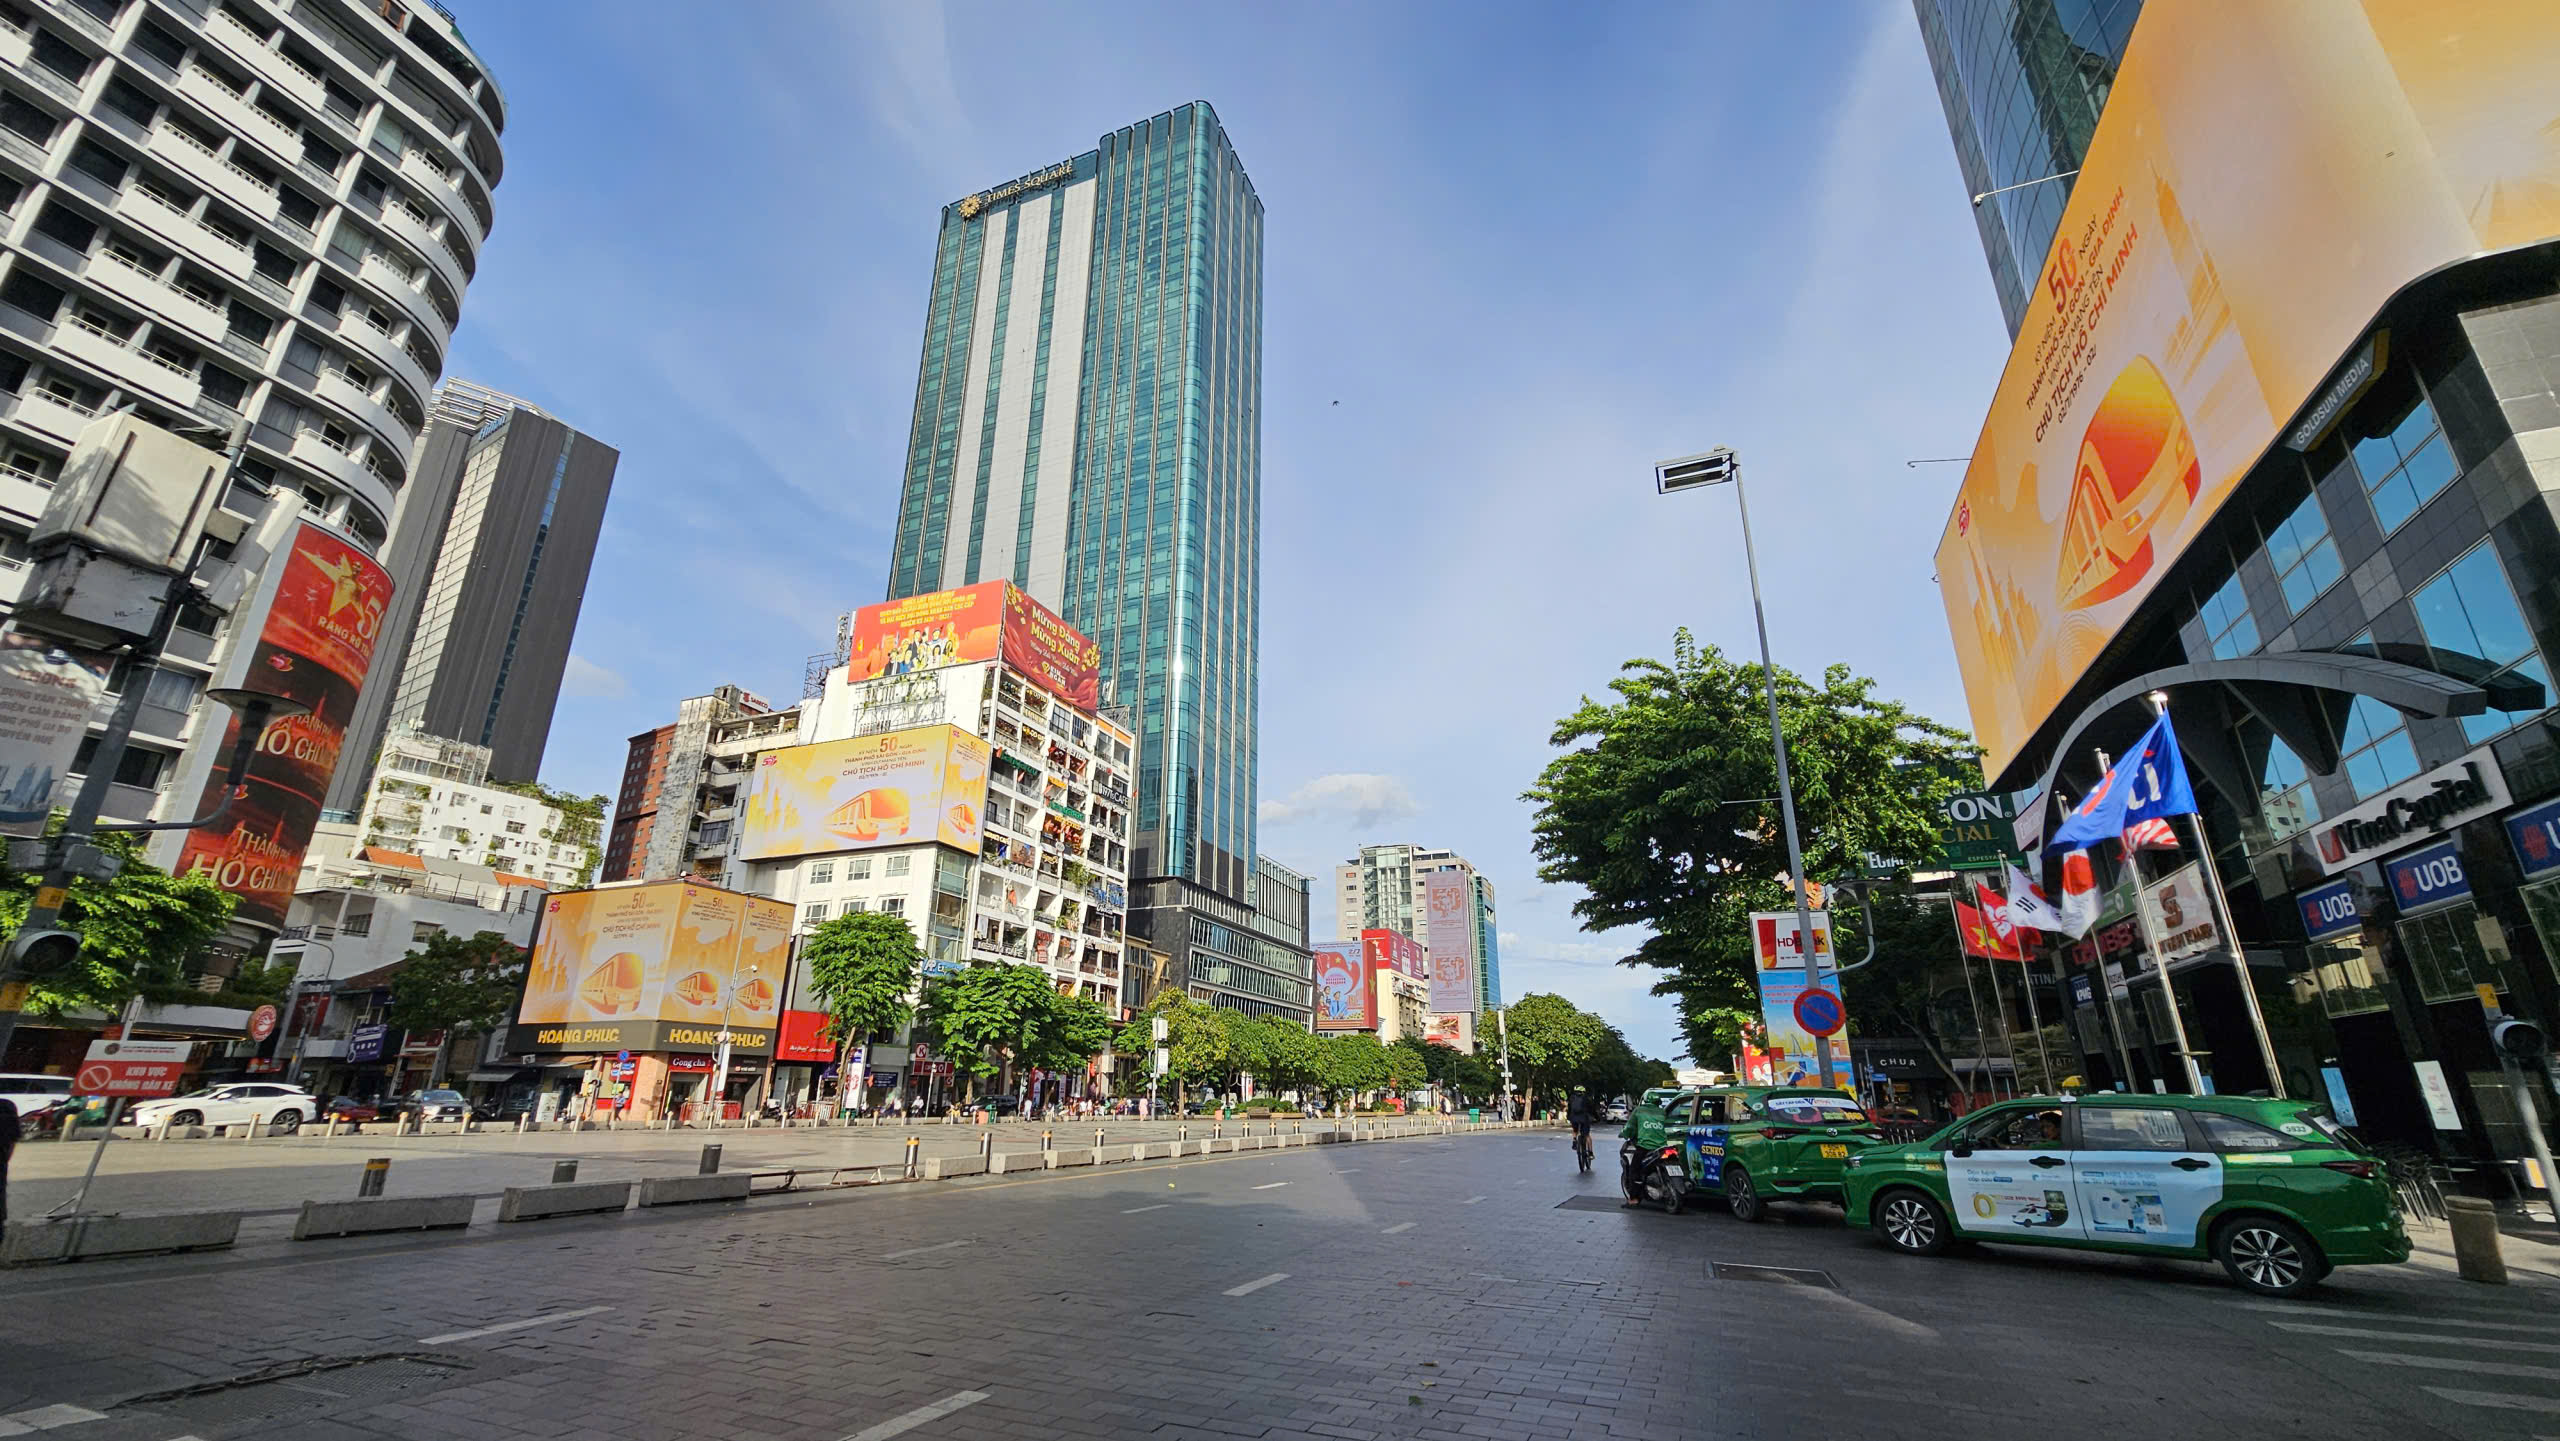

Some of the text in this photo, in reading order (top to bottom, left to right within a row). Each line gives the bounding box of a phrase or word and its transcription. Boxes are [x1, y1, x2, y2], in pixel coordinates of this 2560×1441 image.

[986, 165, 1073, 203] TIMES SQUARE
[2106, 221, 2138, 292] MINH
[2296, 357, 2369, 444] GOLDSUN MEDIA
[1032, 605, 1080, 655] Mừng Đảng
[1031, 622, 1056, 653] Mừng
[1057, 640, 1080, 665] Xuân
[880, 736, 899, 752] 50
[905, 759, 925, 768] MINH
[2332, 761, 2493, 853] VinaCapital
[2413, 855, 2464, 892] UOB
[2318, 892, 2357, 923] UOB
[2075, 986, 2093, 1002] KPMG
[584, 1027, 620, 1043] PHUC
[672, 1057, 706, 1068] Gong cha
[1879, 1057, 1917, 1067] CHUA
[1643, 1120, 1664, 1130] Grab
[1701, 1144, 1725, 1157] SENKO
